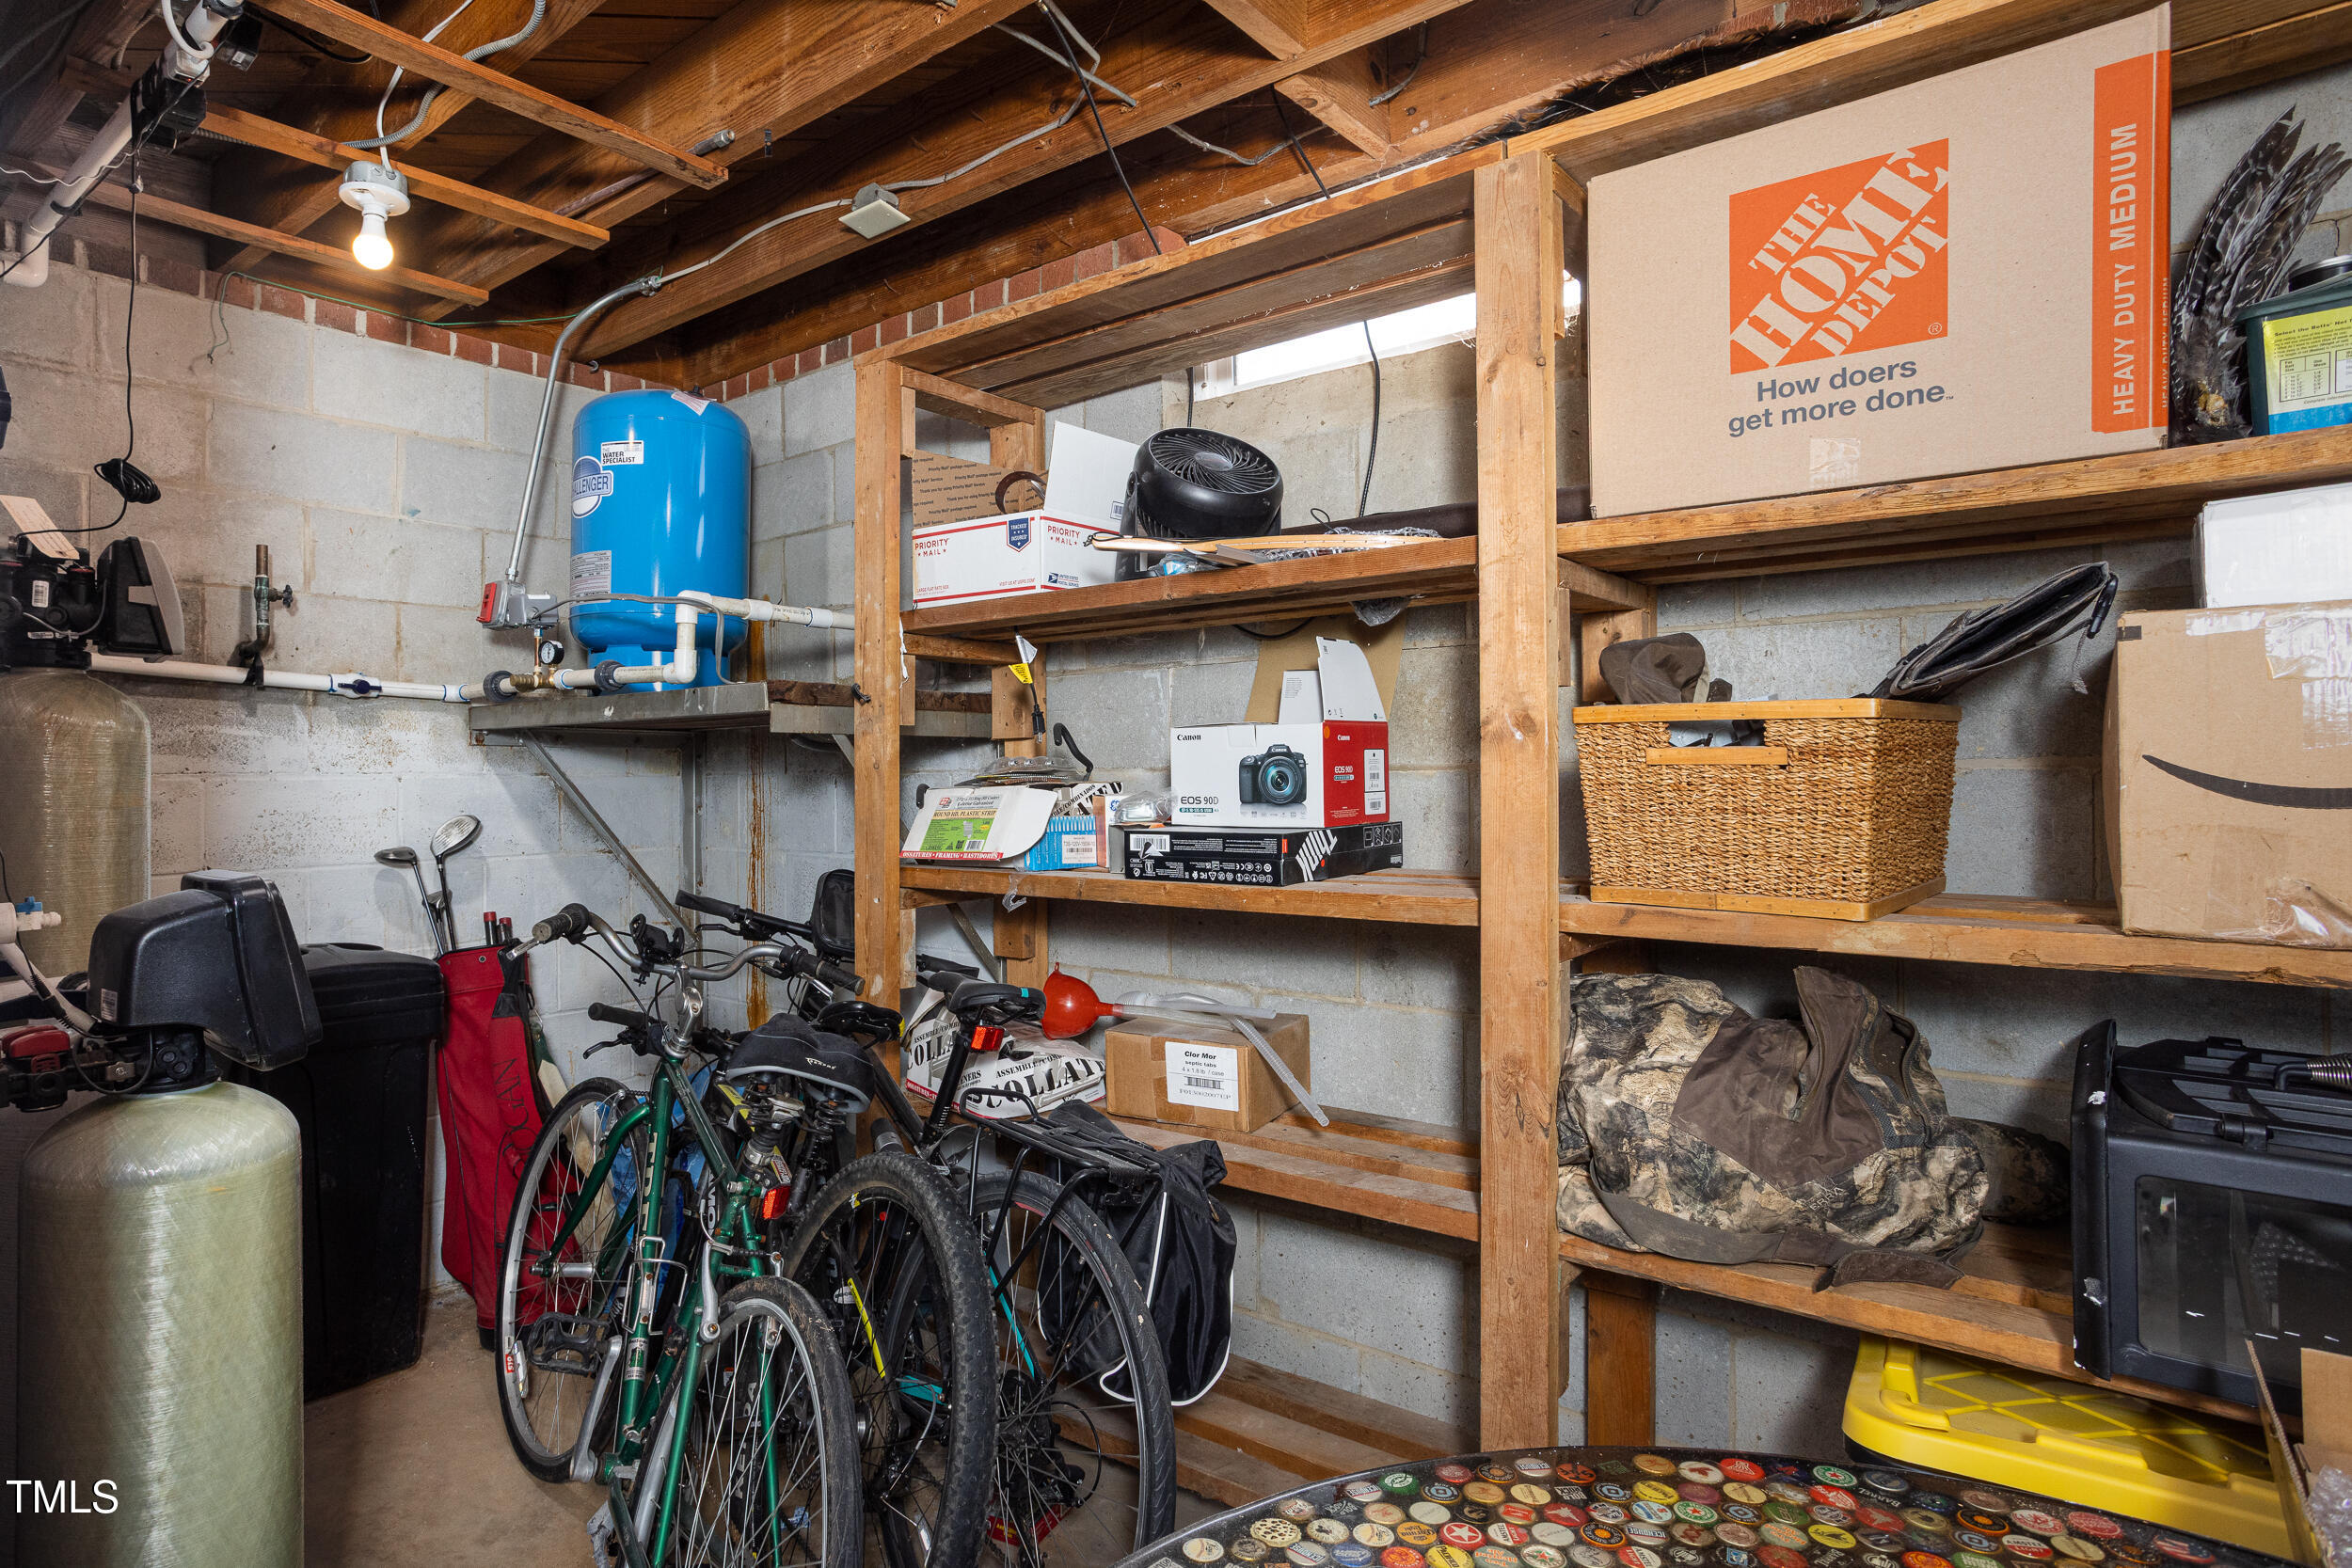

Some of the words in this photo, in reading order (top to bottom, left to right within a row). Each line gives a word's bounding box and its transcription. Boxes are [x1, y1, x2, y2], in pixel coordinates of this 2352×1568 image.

[2109, 122, 2137, 251] MEDIUM
[1747, 192, 1837, 276] THE
[1730, 149, 1948, 369] HOME
[1809, 214, 1948, 356] DEPOT
[2114, 262, 2136, 328] DUTY
[1756, 376, 1820, 402] How
[1829, 359, 1917, 388] doers
[2113, 336, 2135, 415] HEAVY
[1727, 407, 1773, 438] get
[1781, 397, 1856, 425] more
[1048, 525, 1081, 539] PRIORITY
[914, 538, 949, 550] PRIORITY
[1056, 536, 1073, 546] MAIL
[1181, 796, 1202, 805] EOS
[1204, 796, 1219, 805] 90D
[1517, 1463, 1551, 1471] ICEHOUSE
[1347, 1484, 1382, 1497] ICEHOUSE
[1563, 1492, 1588, 1500] BOLD
[1858, 1488, 1901, 1507] BARREL
[1325, 1502, 1343, 1514] ROCK
[1340, 1503, 1359, 1515] BOLD
[1400, 1528, 1437, 1537] Corona
[1498, 1523, 1511, 1543] AMSTEL
[1509, 1526, 1520, 1542] LIGHT
[1628, 1527, 1667, 1539] ICEHOUSE
[2006, 1539, 2043, 1547] AMSTEL
[1289, 1543, 1326, 1563] ICEHOUSE
[1475, 1552, 1518, 1563] Hearted
